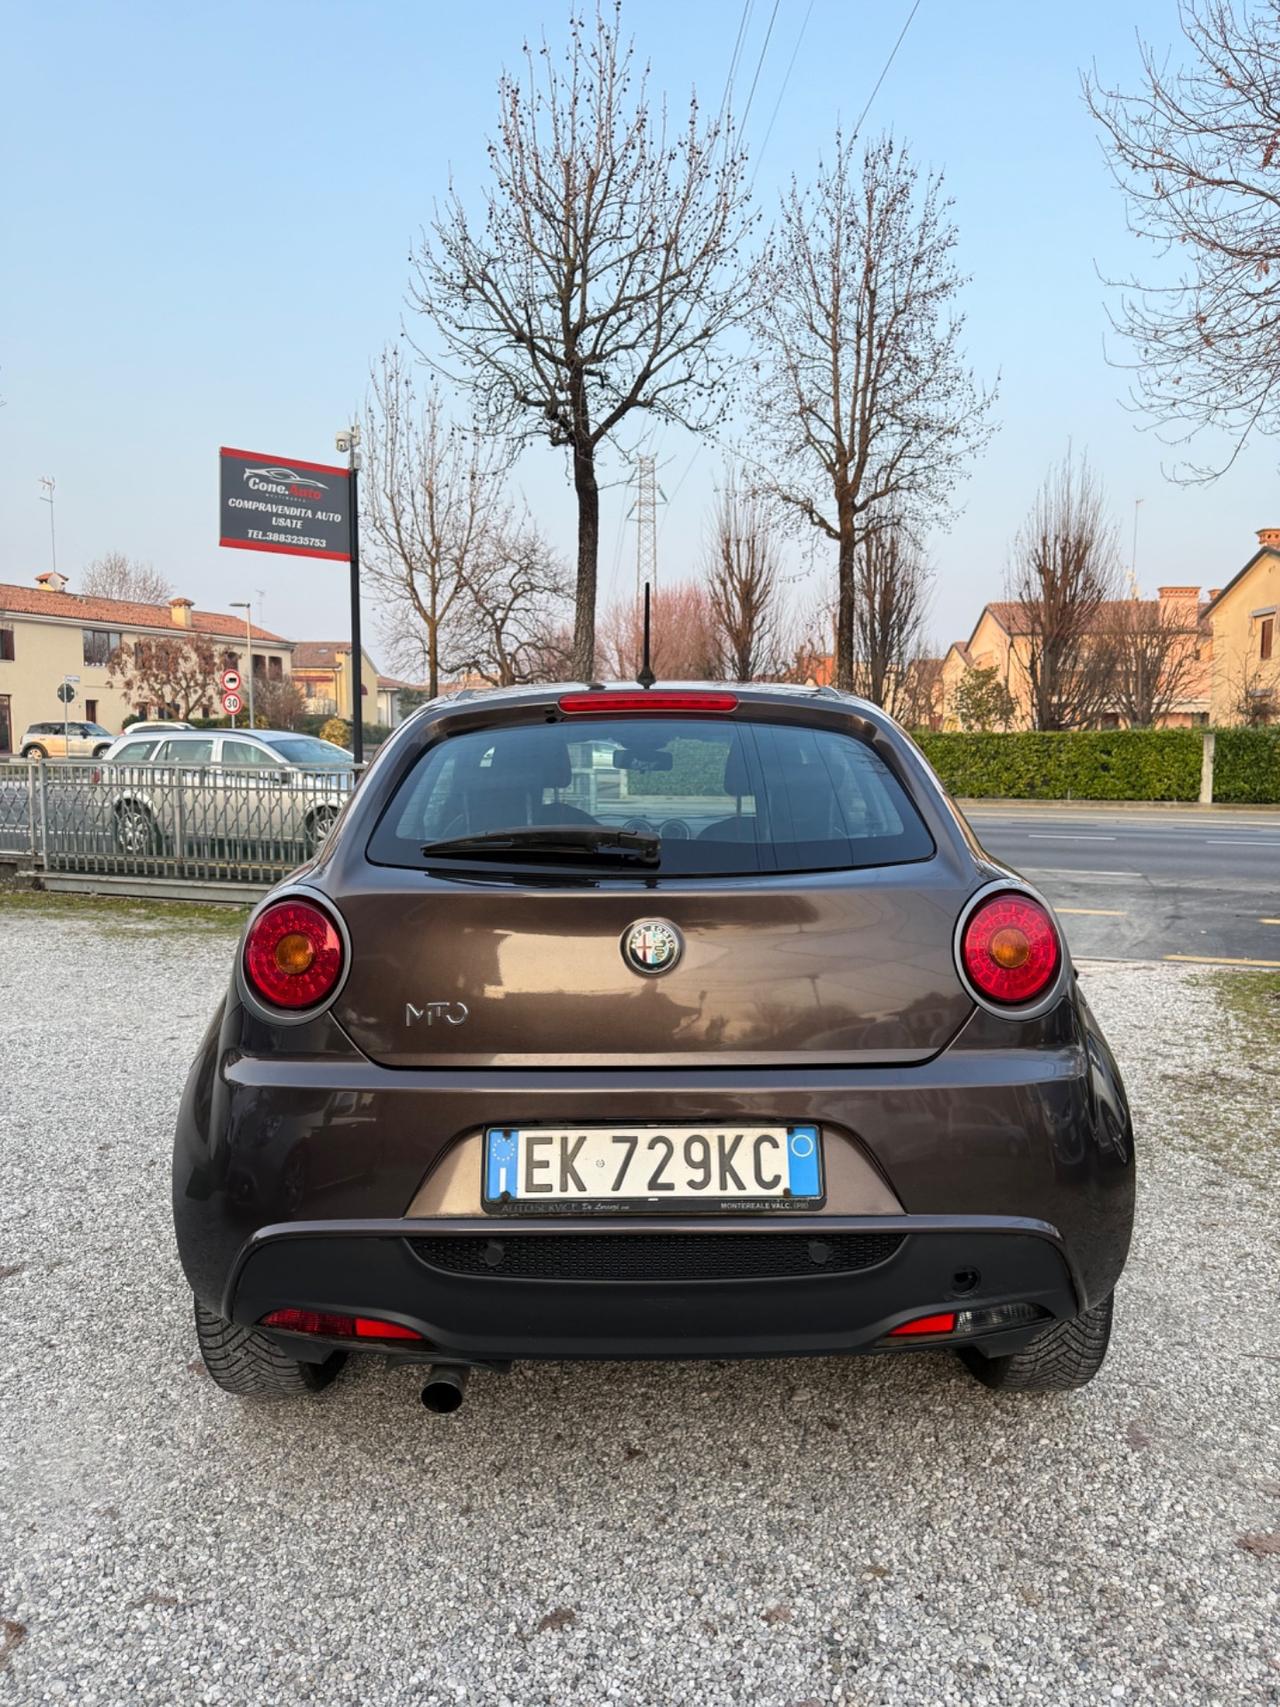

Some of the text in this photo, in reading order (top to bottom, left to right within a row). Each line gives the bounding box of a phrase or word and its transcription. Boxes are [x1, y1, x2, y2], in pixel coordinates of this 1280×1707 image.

[228, 498, 341, 522] COMPRAVENDITA AUTO
[272, 516, 303, 529] USATE
[227, 698, 238, 709] 30
[525, 1134, 782, 1193] EK 729KC
